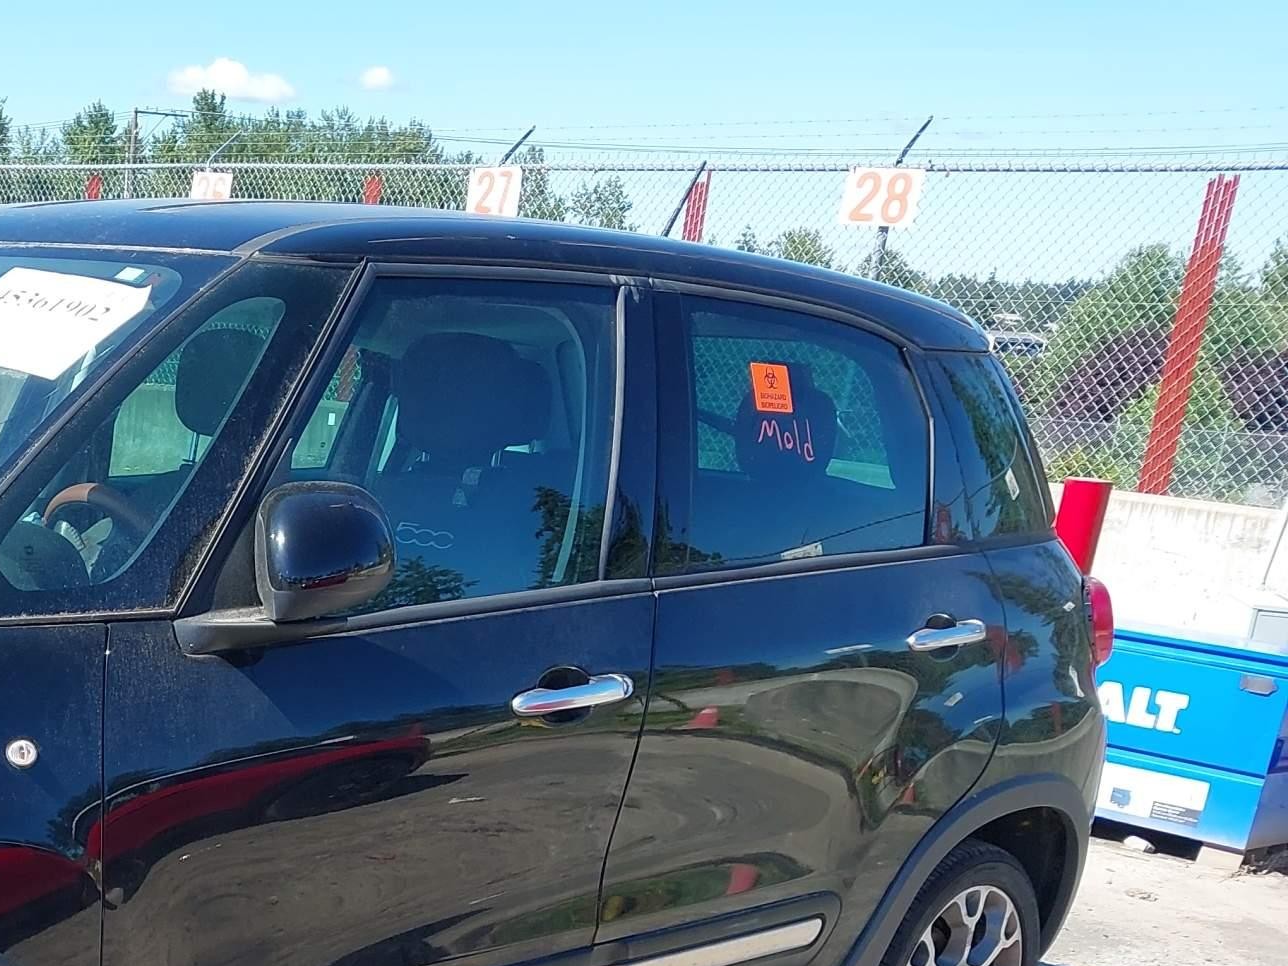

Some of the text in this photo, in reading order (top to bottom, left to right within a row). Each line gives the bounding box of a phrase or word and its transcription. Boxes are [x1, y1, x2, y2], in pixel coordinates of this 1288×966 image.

[475, 170, 514, 213] 27
[848, 171, 913, 224] 28
[758, 418, 815, 462] Mold
[395, 522, 455, 550] 500
